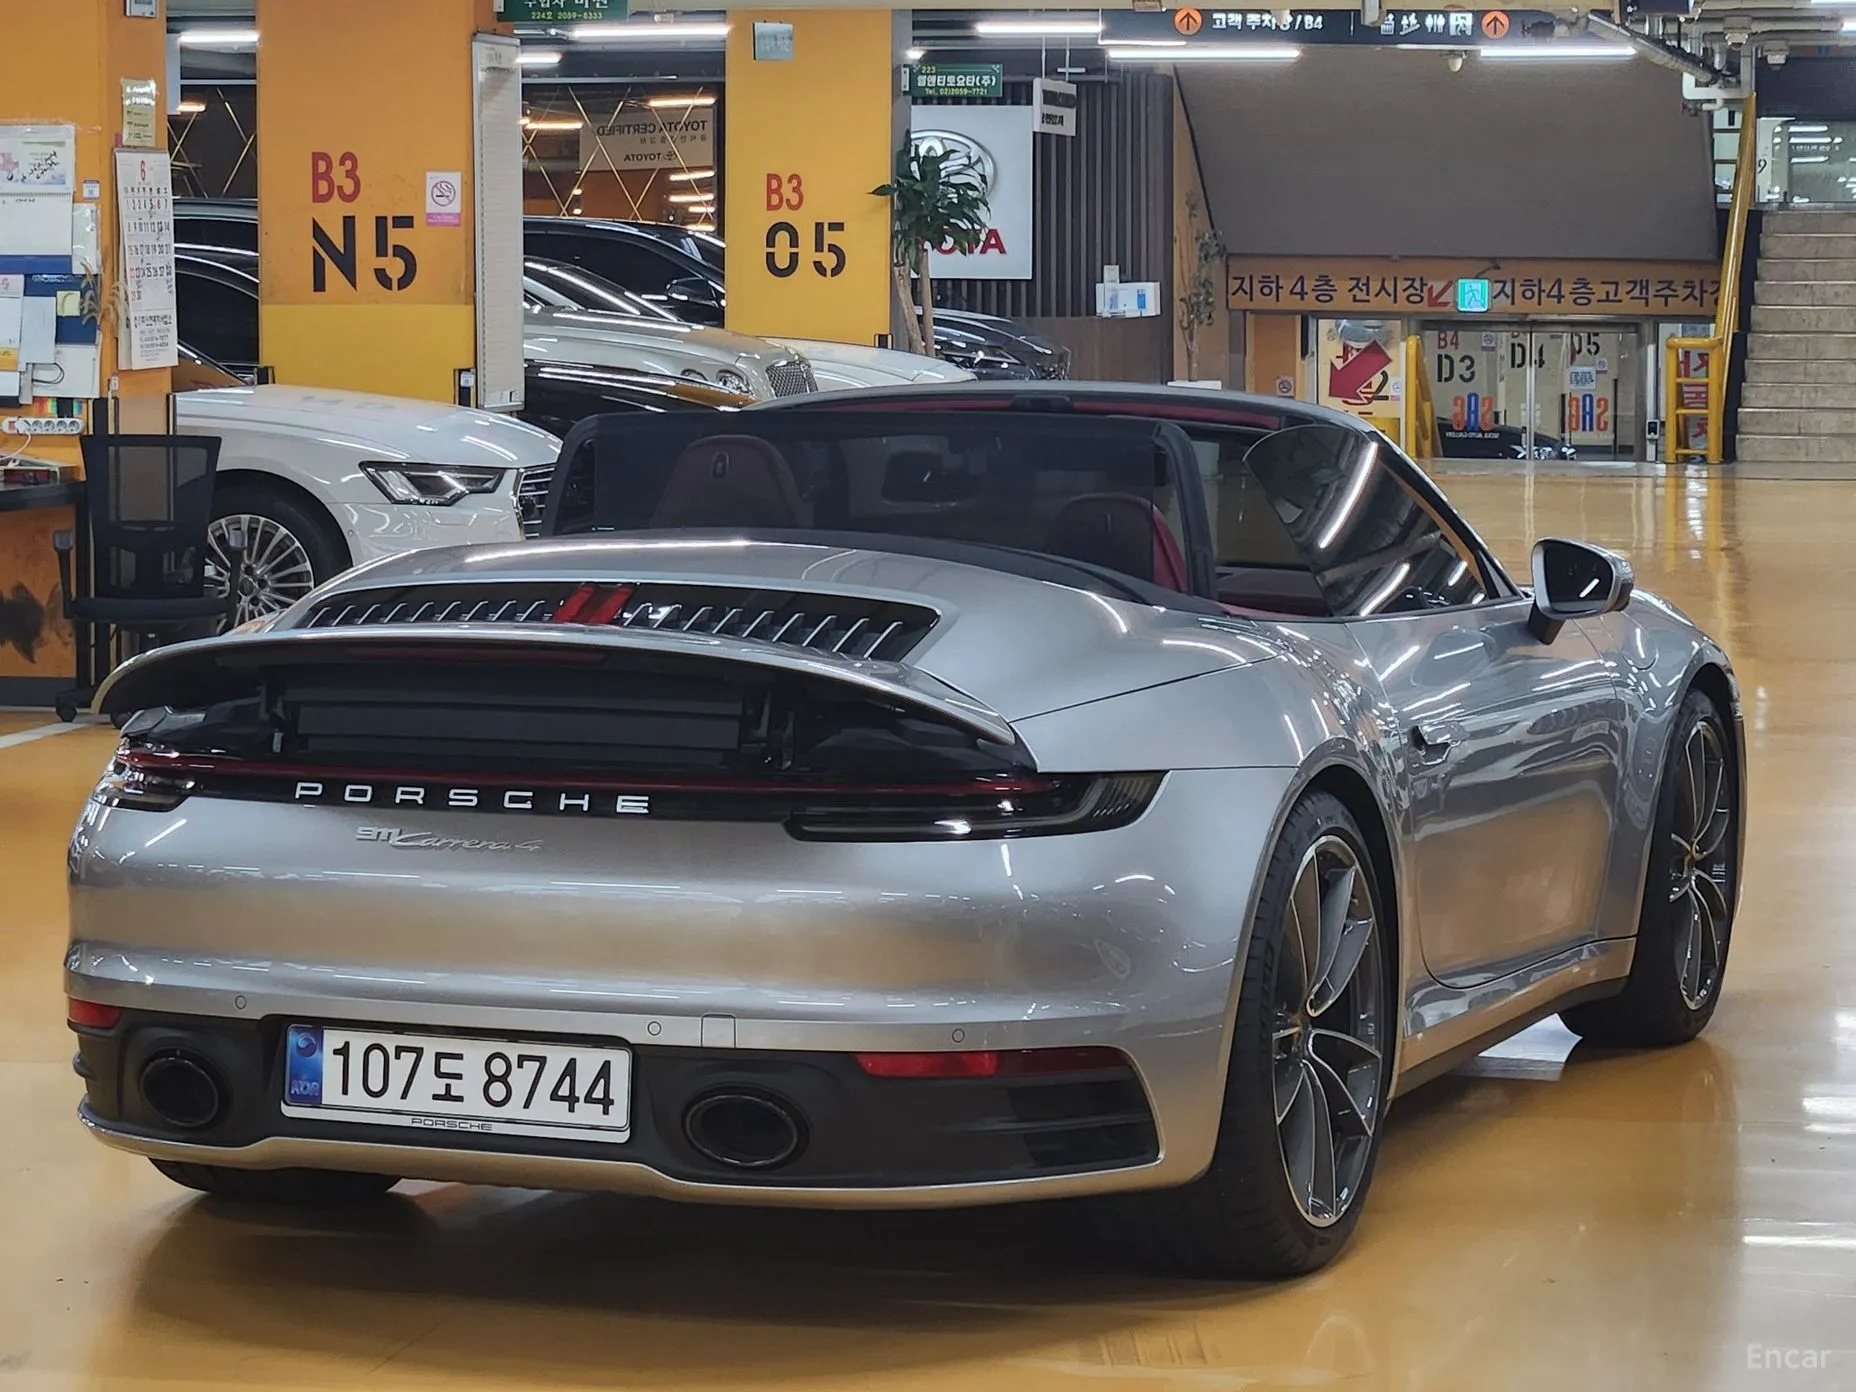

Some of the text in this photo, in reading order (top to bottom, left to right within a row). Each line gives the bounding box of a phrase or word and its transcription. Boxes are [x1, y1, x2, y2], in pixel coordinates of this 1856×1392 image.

[1212, 12, 1242, 30] 고객
[921, 66, 936, 74] 223
[140, 160, 146, 181] 6
[312, 151, 361, 204] B3
[766, 173, 804, 211] B3
[312, 215, 417, 292] N5
[1348, 276, 1428, 305] 전시장
[1437, 330, 1460, 350] B4
[1437, 354, 1475, 383] D3
[295, 782, 650, 814] PORSCHE
[389, 831, 511, 851] Carrera
[333, 1041, 615, 1115] 107도 8744
[411, 1117, 492, 1131] PORSCHE
